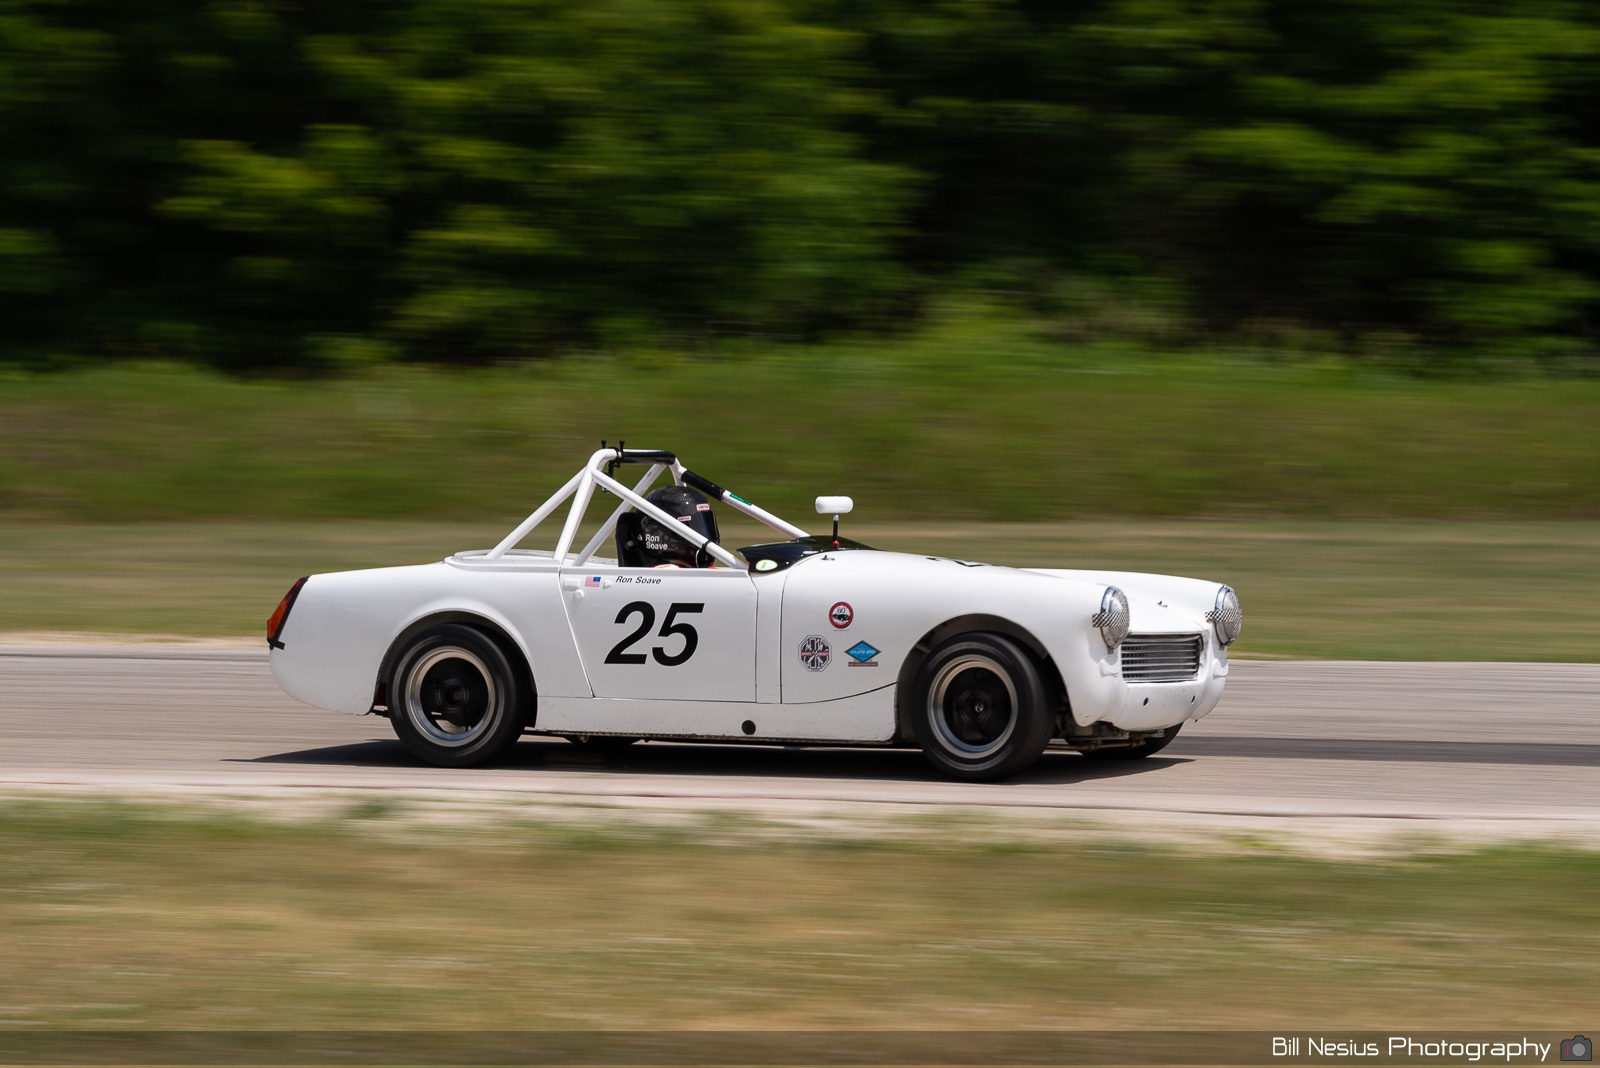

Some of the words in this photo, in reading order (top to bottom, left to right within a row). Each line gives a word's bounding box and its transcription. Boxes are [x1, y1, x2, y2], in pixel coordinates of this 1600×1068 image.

[645, 534, 660, 542] Ron
[645, 542, 668, 550] Soave
[615, 576, 633, 584] Ron
[635, 576, 662, 585] Soave
[603, 600, 705, 667] 25
